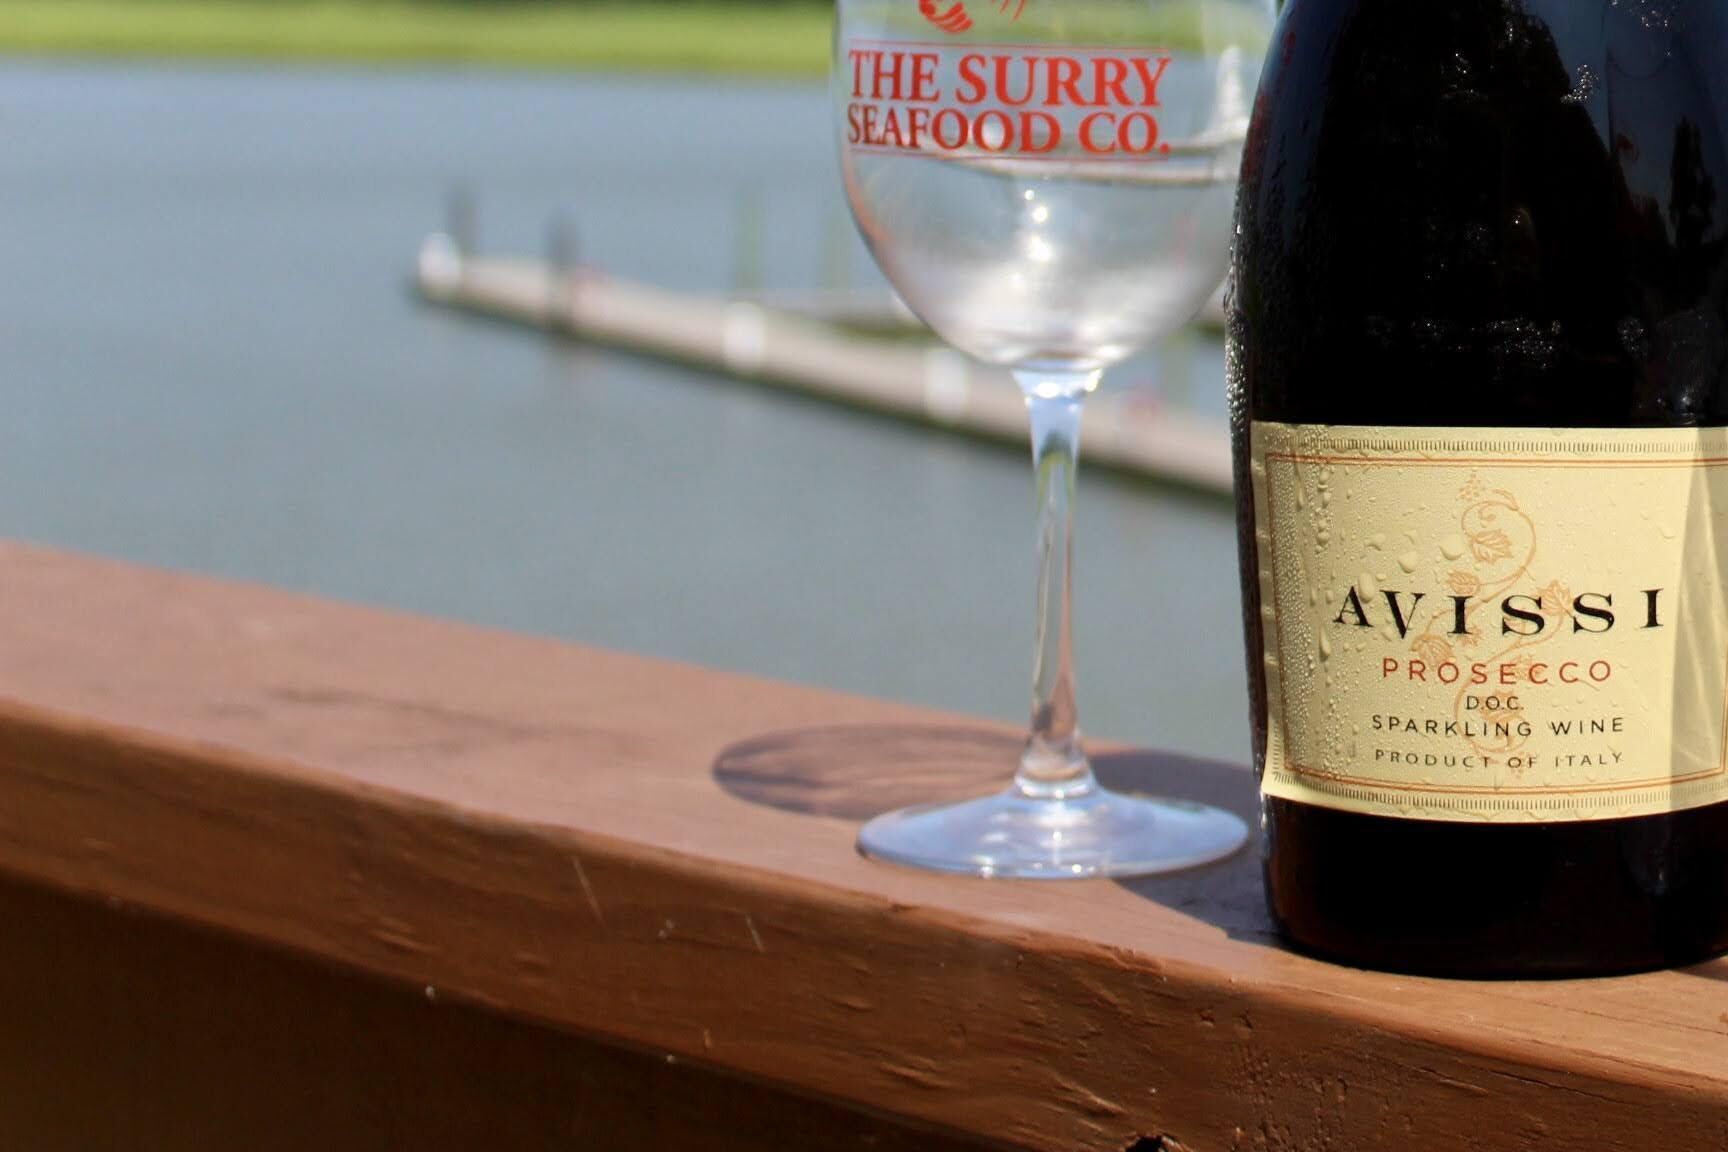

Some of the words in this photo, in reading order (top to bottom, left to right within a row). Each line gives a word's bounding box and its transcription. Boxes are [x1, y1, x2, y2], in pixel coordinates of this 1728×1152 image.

[849, 50, 940, 101] THE
[955, 53, 1172, 107] SURRY
[848, 102, 1061, 153] SEAFOOD
[1078, 111, 1171, 155] CO.
[1333, 586, 1664, 639] AVISSI
[1382, 657, 1611, 685] PROSECCO
[1466, 695, 1524, 711] D.O.C.
[1372, 714, 1532, 737] SPARKLING
[1551, 717, 1624, 735] WINE
[1375, 748, 1490, 768] PRODUCT
[1508, 756, 1537, 769] OF
[1555, 751, 1622, 767] ITALY
